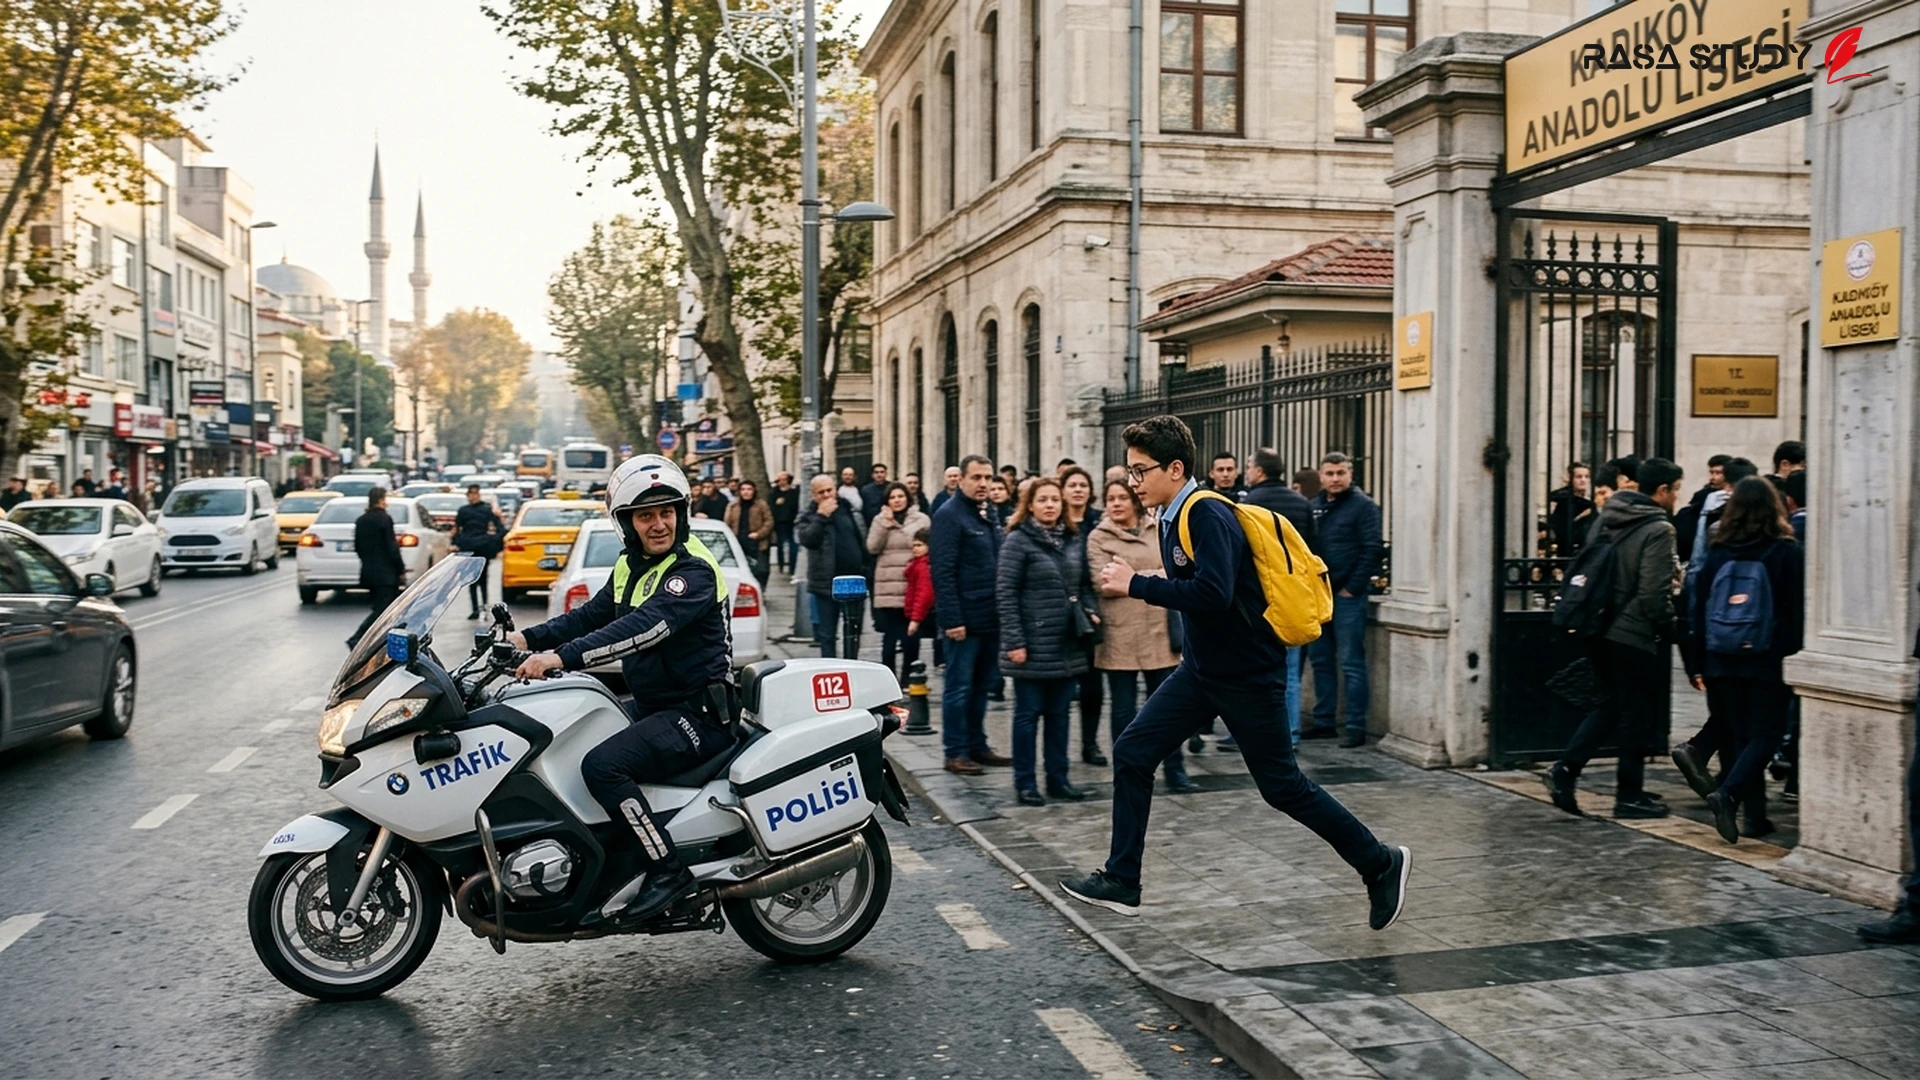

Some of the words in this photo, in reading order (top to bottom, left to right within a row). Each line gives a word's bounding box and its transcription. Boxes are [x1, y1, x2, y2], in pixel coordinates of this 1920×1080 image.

[1522, 70, 1662, 158] ANADOLU
[817, 676, 844, 696] 112
[420, 740, 511, 791] TRAFİK
[765, 771, 860, 832] POLİSİ
